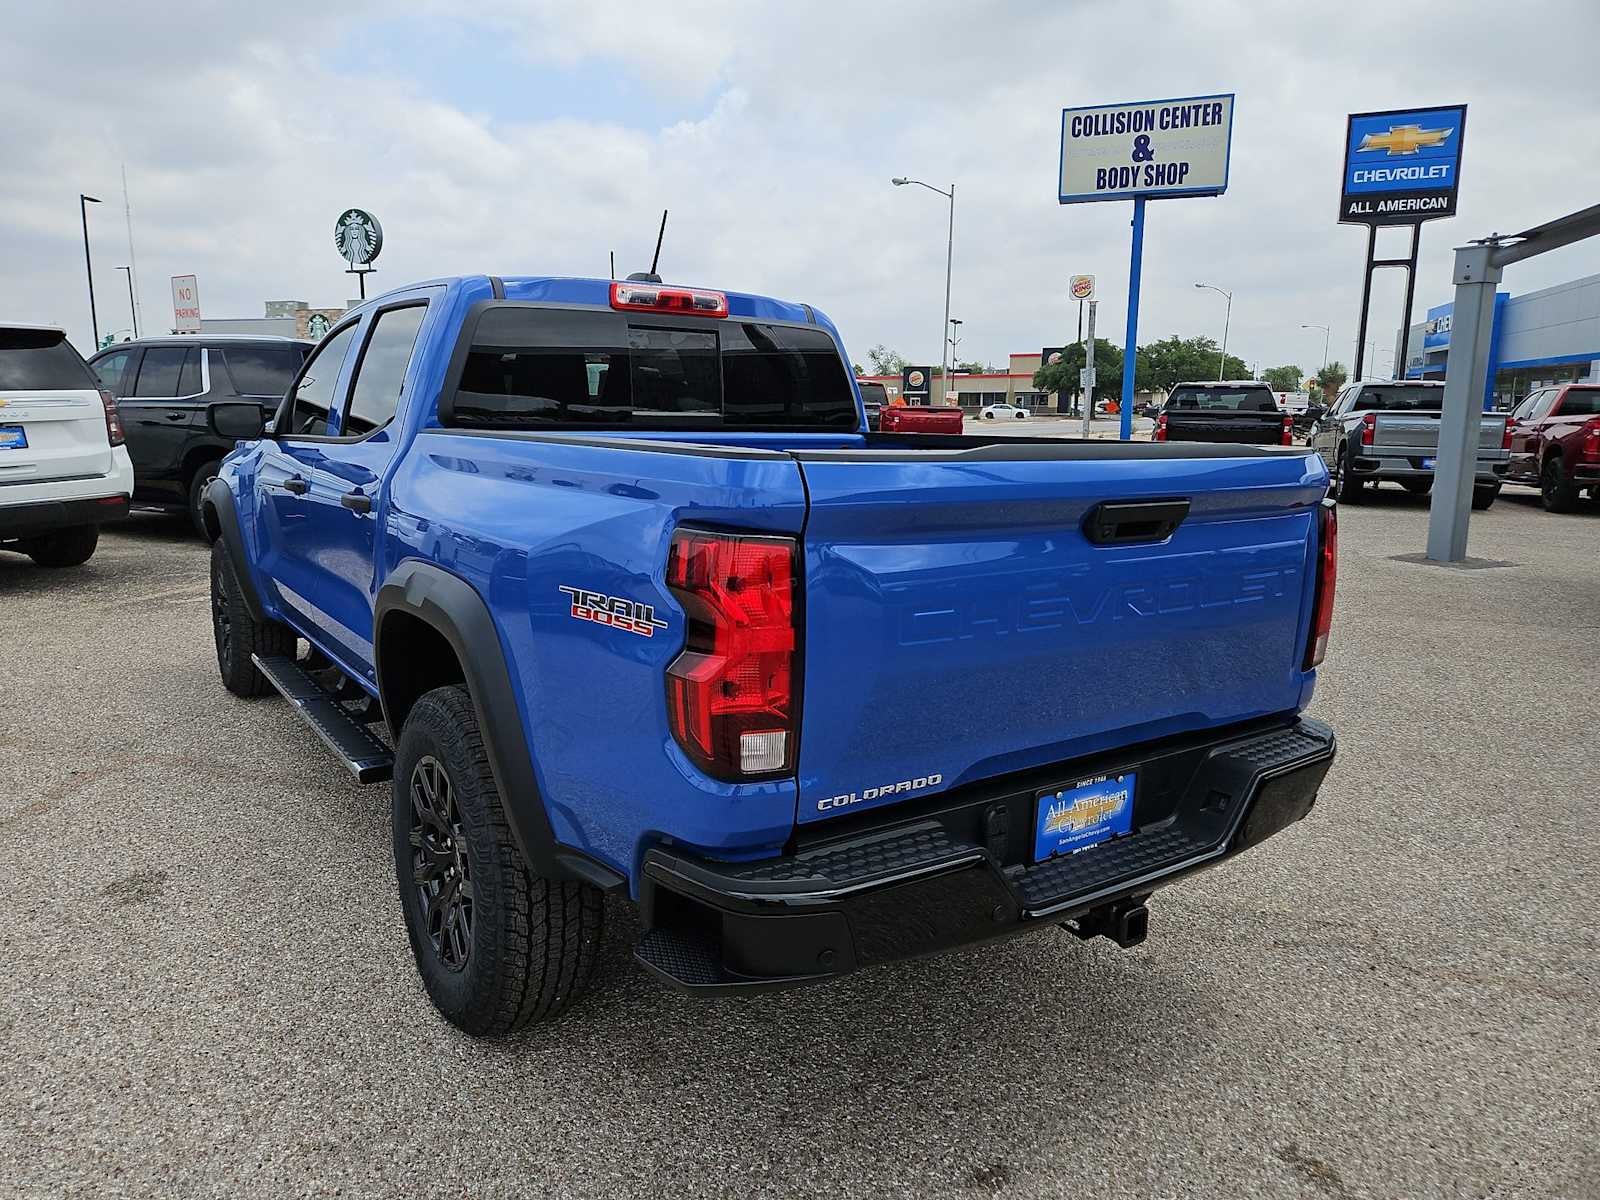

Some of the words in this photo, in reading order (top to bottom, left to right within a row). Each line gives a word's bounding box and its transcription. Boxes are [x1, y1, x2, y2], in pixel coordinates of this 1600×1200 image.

[1071, 109, 1155, 138] COLLISION
[1159, 102, 1223, 131] CENTER
[1132, 135, 1154, 162] &
[1096, 166, 1141, 190] BODY
[1144, 162, 1189, 187] SHOP
[1353, 165, 1450, 183] CHEVROLET
[1348, 201, 1374, 214] ALL
[1377, 197, 1448, 212] AMERICAN
[179, 288, 191, 301] NO
[176, 307, 199, 319] PARKING
[559, 585, 668, 629] TRAIL
[571, 604, 654, 637] BOSS
[896, 568, 1298, 647] CHEVROLET
[817, 774, 943, 811] COLORADO
[1046, 799, 1066, 820] All
[1068, 789, 1128, 811] American
[1058, 807, 1112, 834] Chevrolet
